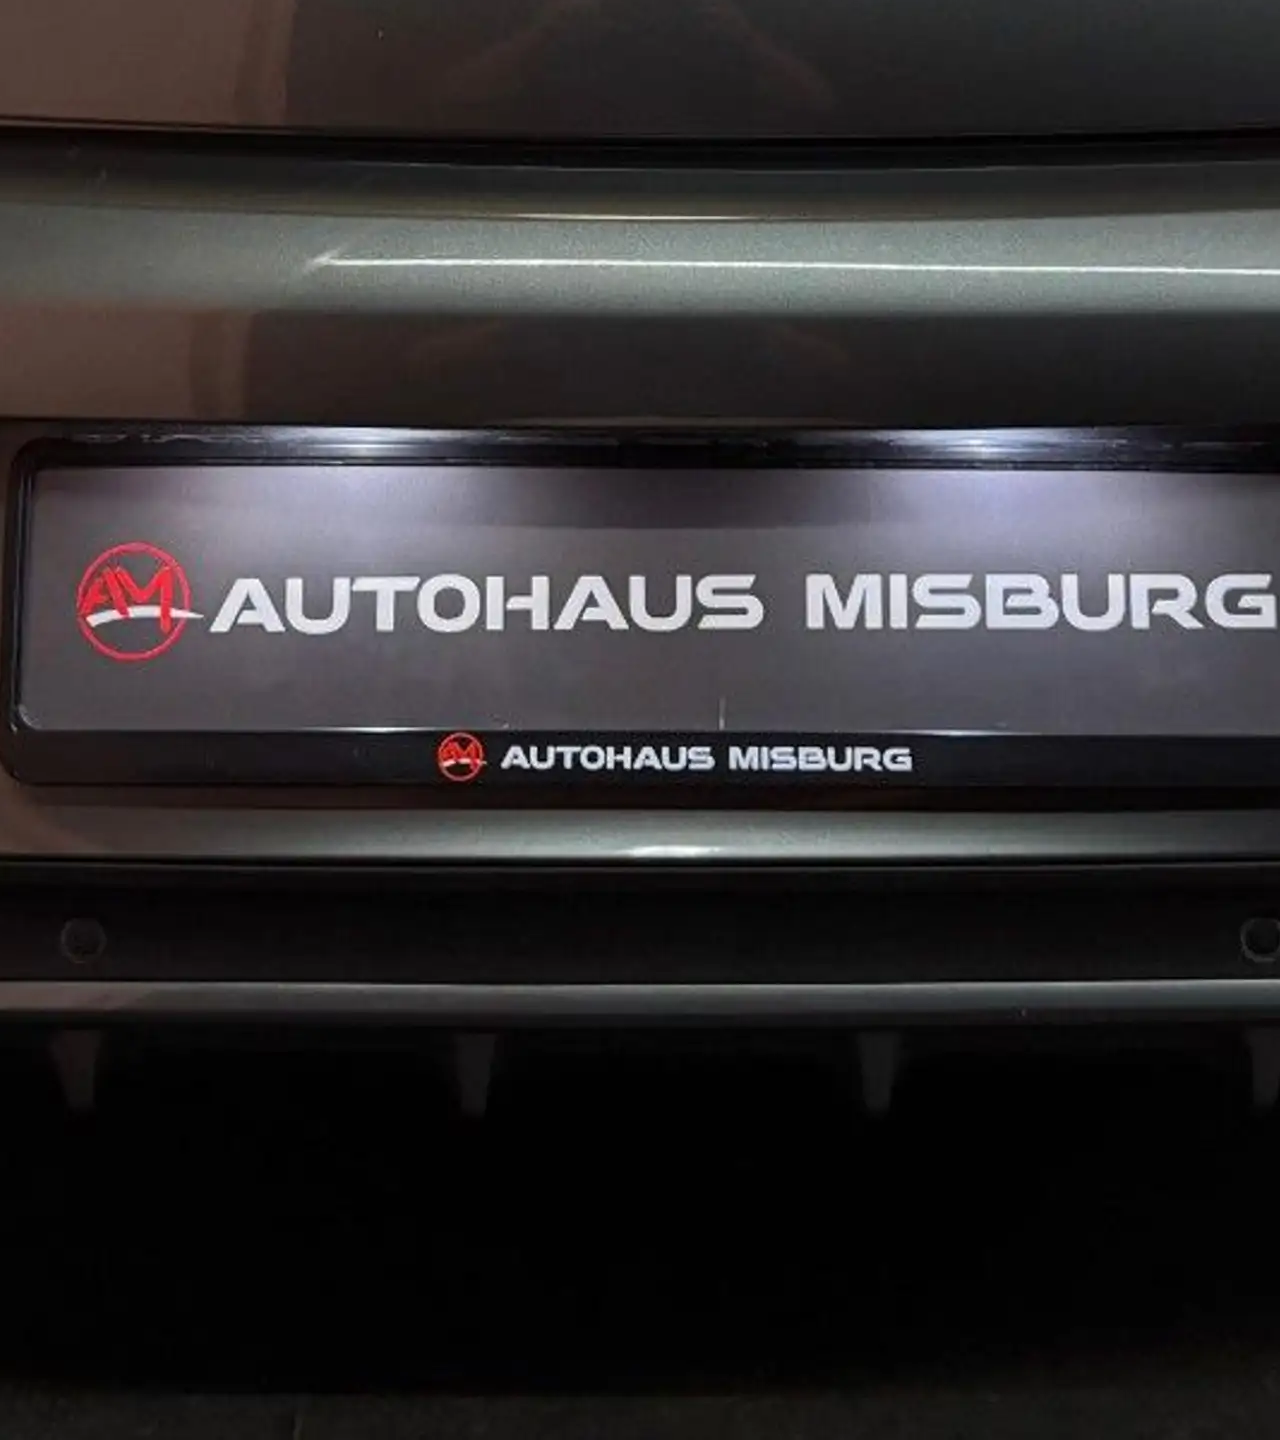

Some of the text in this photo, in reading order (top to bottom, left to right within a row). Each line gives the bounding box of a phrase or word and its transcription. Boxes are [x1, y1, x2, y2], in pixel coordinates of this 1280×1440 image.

[209, 573, 764, 635] AUTOHAUS
[806, 572, 1276, 632] MISBURG
[500, 745, 716, 771] AUTOHAUS
[728, 745, 914, 772] MISBURG
